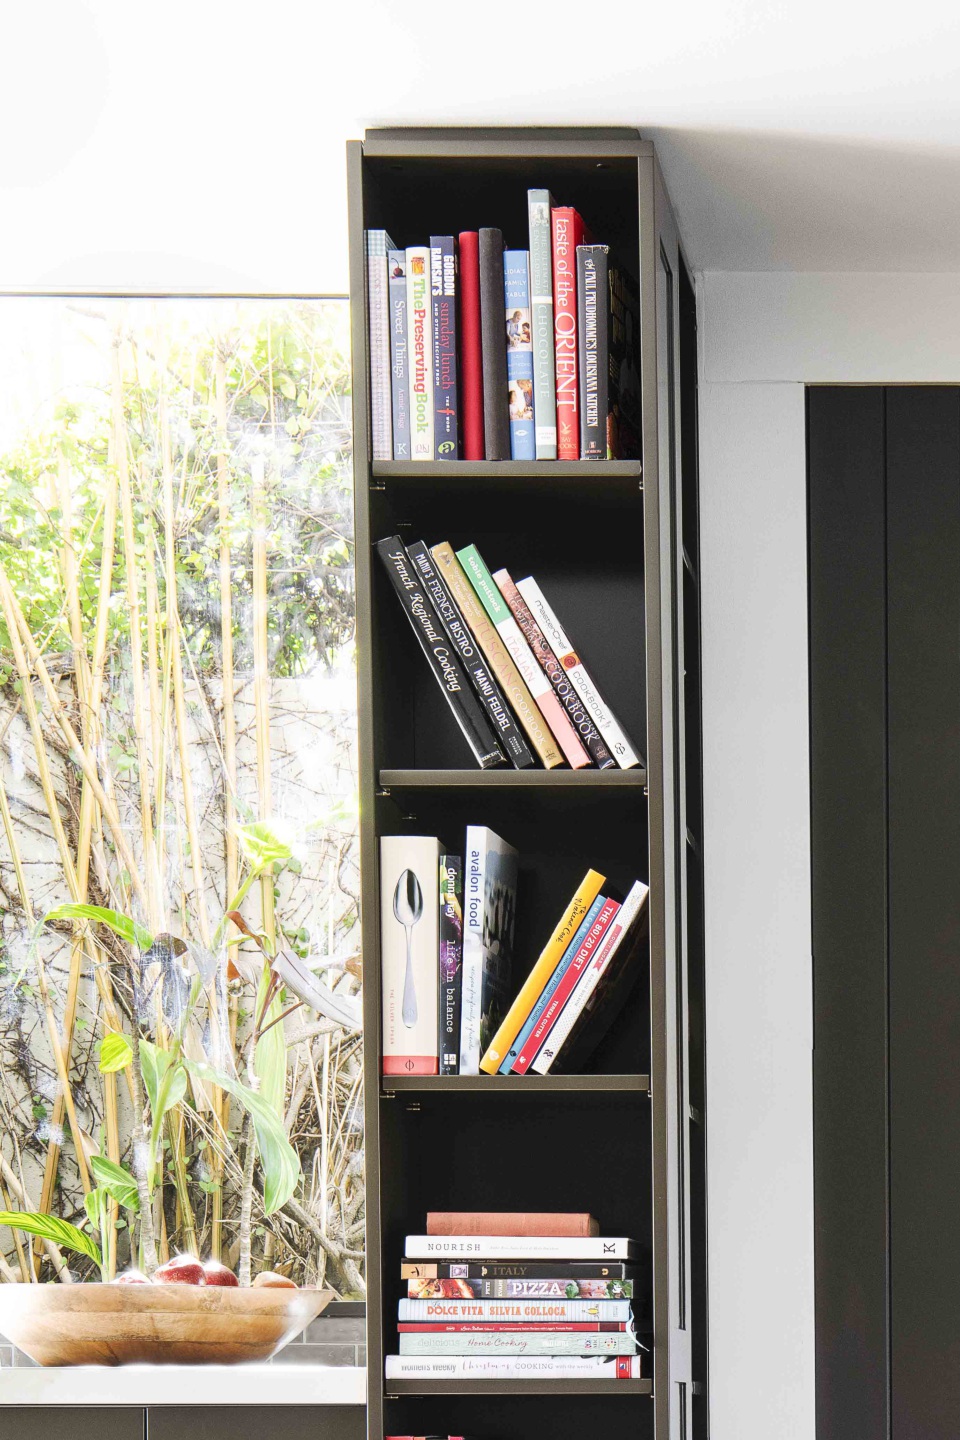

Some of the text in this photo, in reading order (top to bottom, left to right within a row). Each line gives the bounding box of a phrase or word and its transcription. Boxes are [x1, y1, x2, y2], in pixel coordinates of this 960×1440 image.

[431, 247, 443, 297] RAMSAY'S
[443, 255, 455, 297] GORDON
[505, 279, 527, 287] FAMILY
[533, 229, 541, 295] ENCYCLOPEDIA
[540, 229, 549, 296] THE ULTIMATE
[394, 300, 405, 334] Sweet
[505, 290, 526, 298] TABLE
[554, 217, 577, 412] taste of the ORIENT
[393, 338, 406, 379] Things
[438, 302, 455, 390] sunday lunch
[538, 304, 550, 399] CHOCOLATE
[585, 270, 599, 427] PAUL PRUDHOMME'S LOUISIANA KITCHEN
[415, 553, 474, 657] MANU'S FRENCH BISTRO
[468, 555, 502, 613] tobie puttock
[388, 551, 462, 692] French Regional Cooking
[475, 616, 546, 747] TUSCAN COOKBOOK
[506, 635, 536, 683] ITALIAN
[473, 668, 494, 697] MANU
[487, 696, 511, 732] FEILDEL
[543, 659, 597, 745] COOKBOOK
[572, 670, 606, 722] COOKBOOK
[468, 850, 482, 927] avalon food
[444, 867, 458, 1033] donna hay life in balance
[573, 906, 614, 971] THE 80/20 DIET
[534, 1000, 559, 1038] TERESA CUTTER
[427, 1243, 481, 1251] NOURISH
[493, 1267, 528, 1276] ITALY
[427, 1305, 566, 1316] DOLCE VITA SILVIA COLLOCA
[511, 1282, 562, 1295] PIZZA
[467, 1338, 528, 1352] Home Cooking
